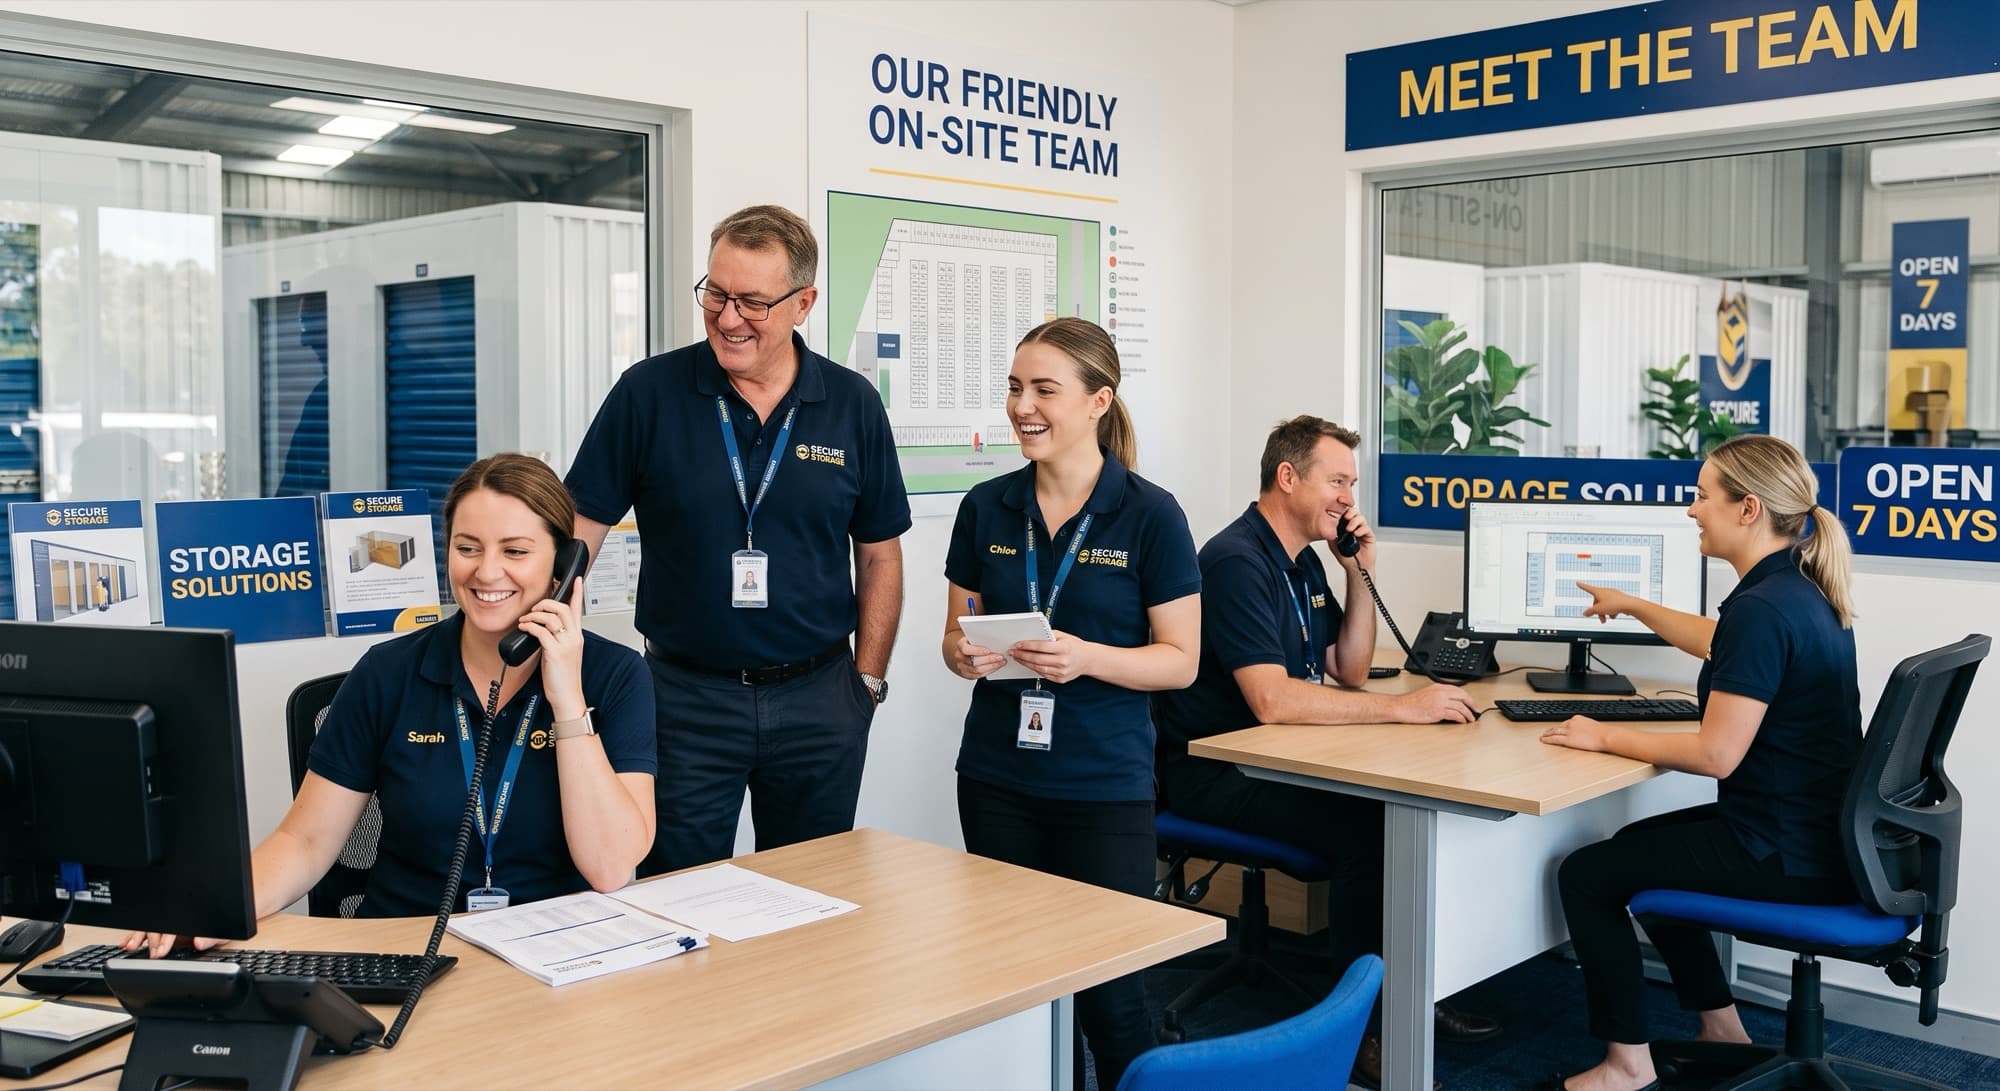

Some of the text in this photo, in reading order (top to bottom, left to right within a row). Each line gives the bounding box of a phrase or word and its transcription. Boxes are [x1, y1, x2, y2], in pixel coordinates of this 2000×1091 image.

[1400, 0, 1919, 118] MEET THE TEAM
[872, 53, 1118, 131] OUR FRIENDLY
[869, 104, 1119, 178] ON-SITE TEAM
[1899, 256, 1959, 277] OPEN
[1916, 279, 1939, 309] 7
[1900, 312, 1957, 331] DAYS
[811, 445, 845, 458] SECURE
[811, 453, 845, 466] STORAGE
[1867, 462, 1993, 501] OPEN
[366, 496, 403, 505] SECURE
[63, 507, 108, 518] SECURE
[367, 504, 404, 513] STORAGE
[64, 516, 109, 526] STORAGE
[1852, 504, 1997, 542] 7 DAYS
[170, 541, 311, 573] STORAGE
[989, 544, 1017, 556] Chloe
[1091, 548, 1129, 560] SECURE
[1090, 557, 1129, 568] STORAGE
[171, 570, 313, 600] SOLUTIONS
[0, 653, 28, 669] on
[407, 731, 446, 744] Sarah
[192, 1043, 231, 1056] Canon
